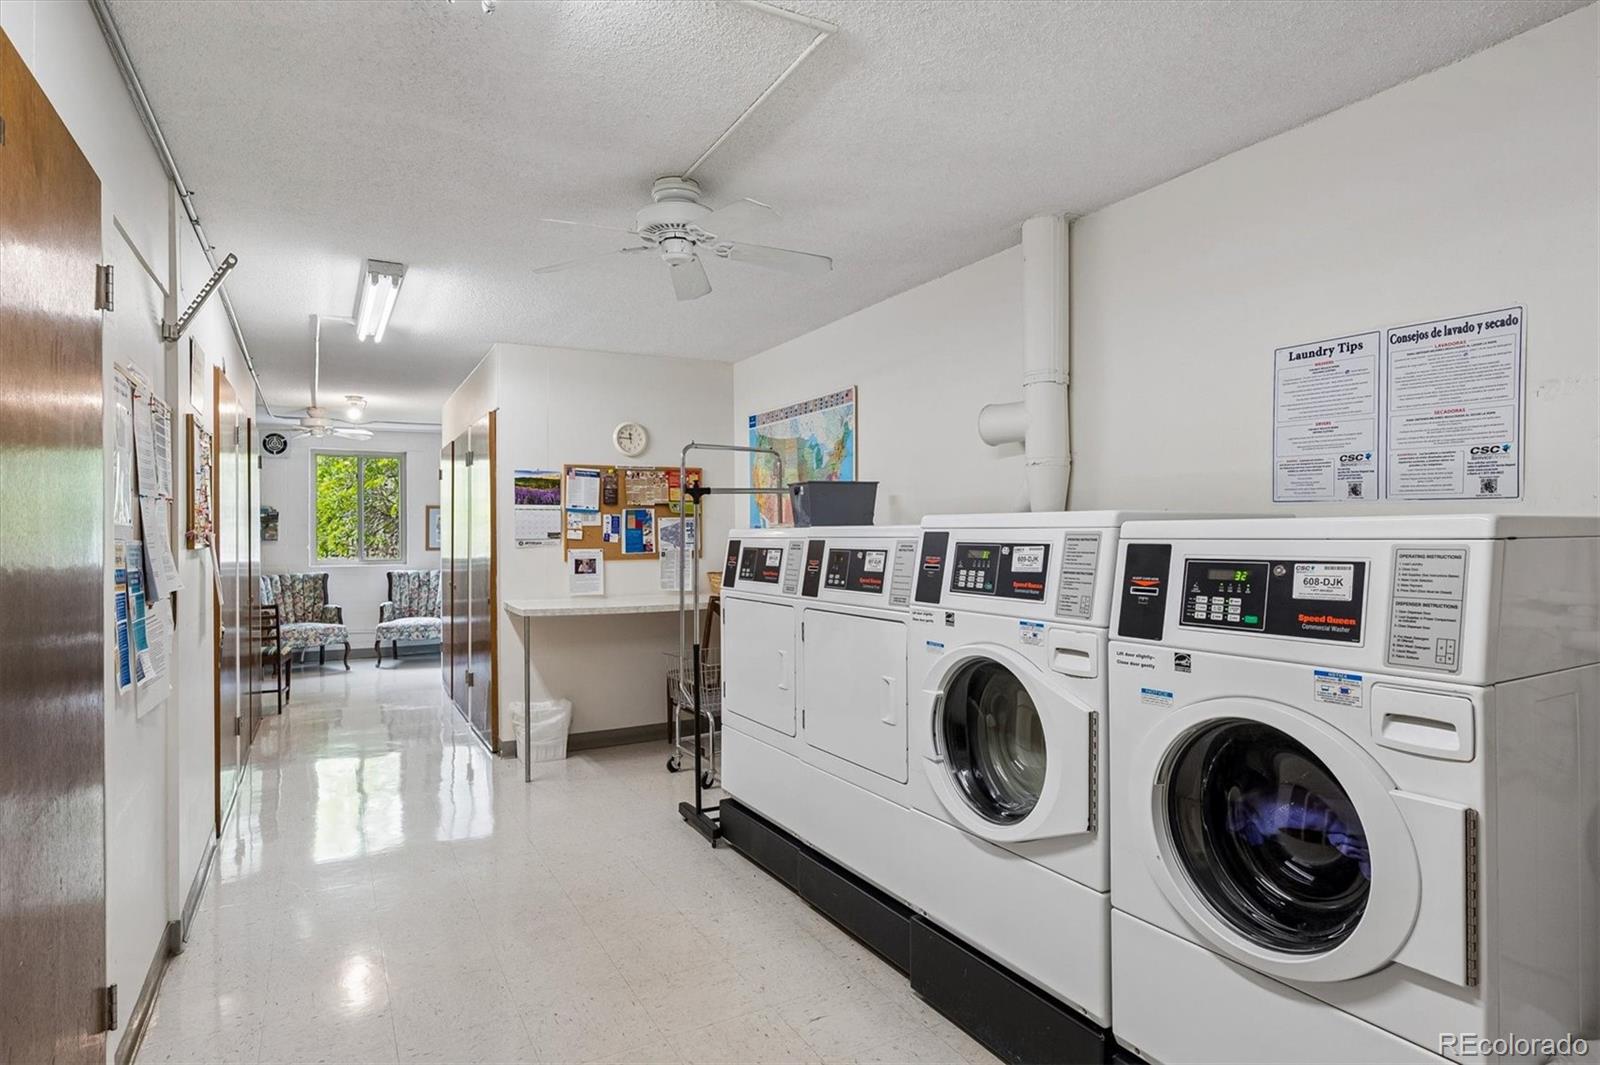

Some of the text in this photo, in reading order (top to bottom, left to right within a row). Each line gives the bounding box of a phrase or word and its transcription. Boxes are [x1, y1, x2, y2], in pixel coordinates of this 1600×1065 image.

[1390, 314, 1519, 344] Consejos de lavado y secado
[1288, 342, 1364, 362] Laundry Tips
[1470, 445, 1501, 454] CSC
[1339, 453, 1364, 462] CSC
[1234, 570, 1248, 581] 32
[1303, 577, 1344, 587] 608-DJK
[1298, 614, 1356, 625] Speed Queen
